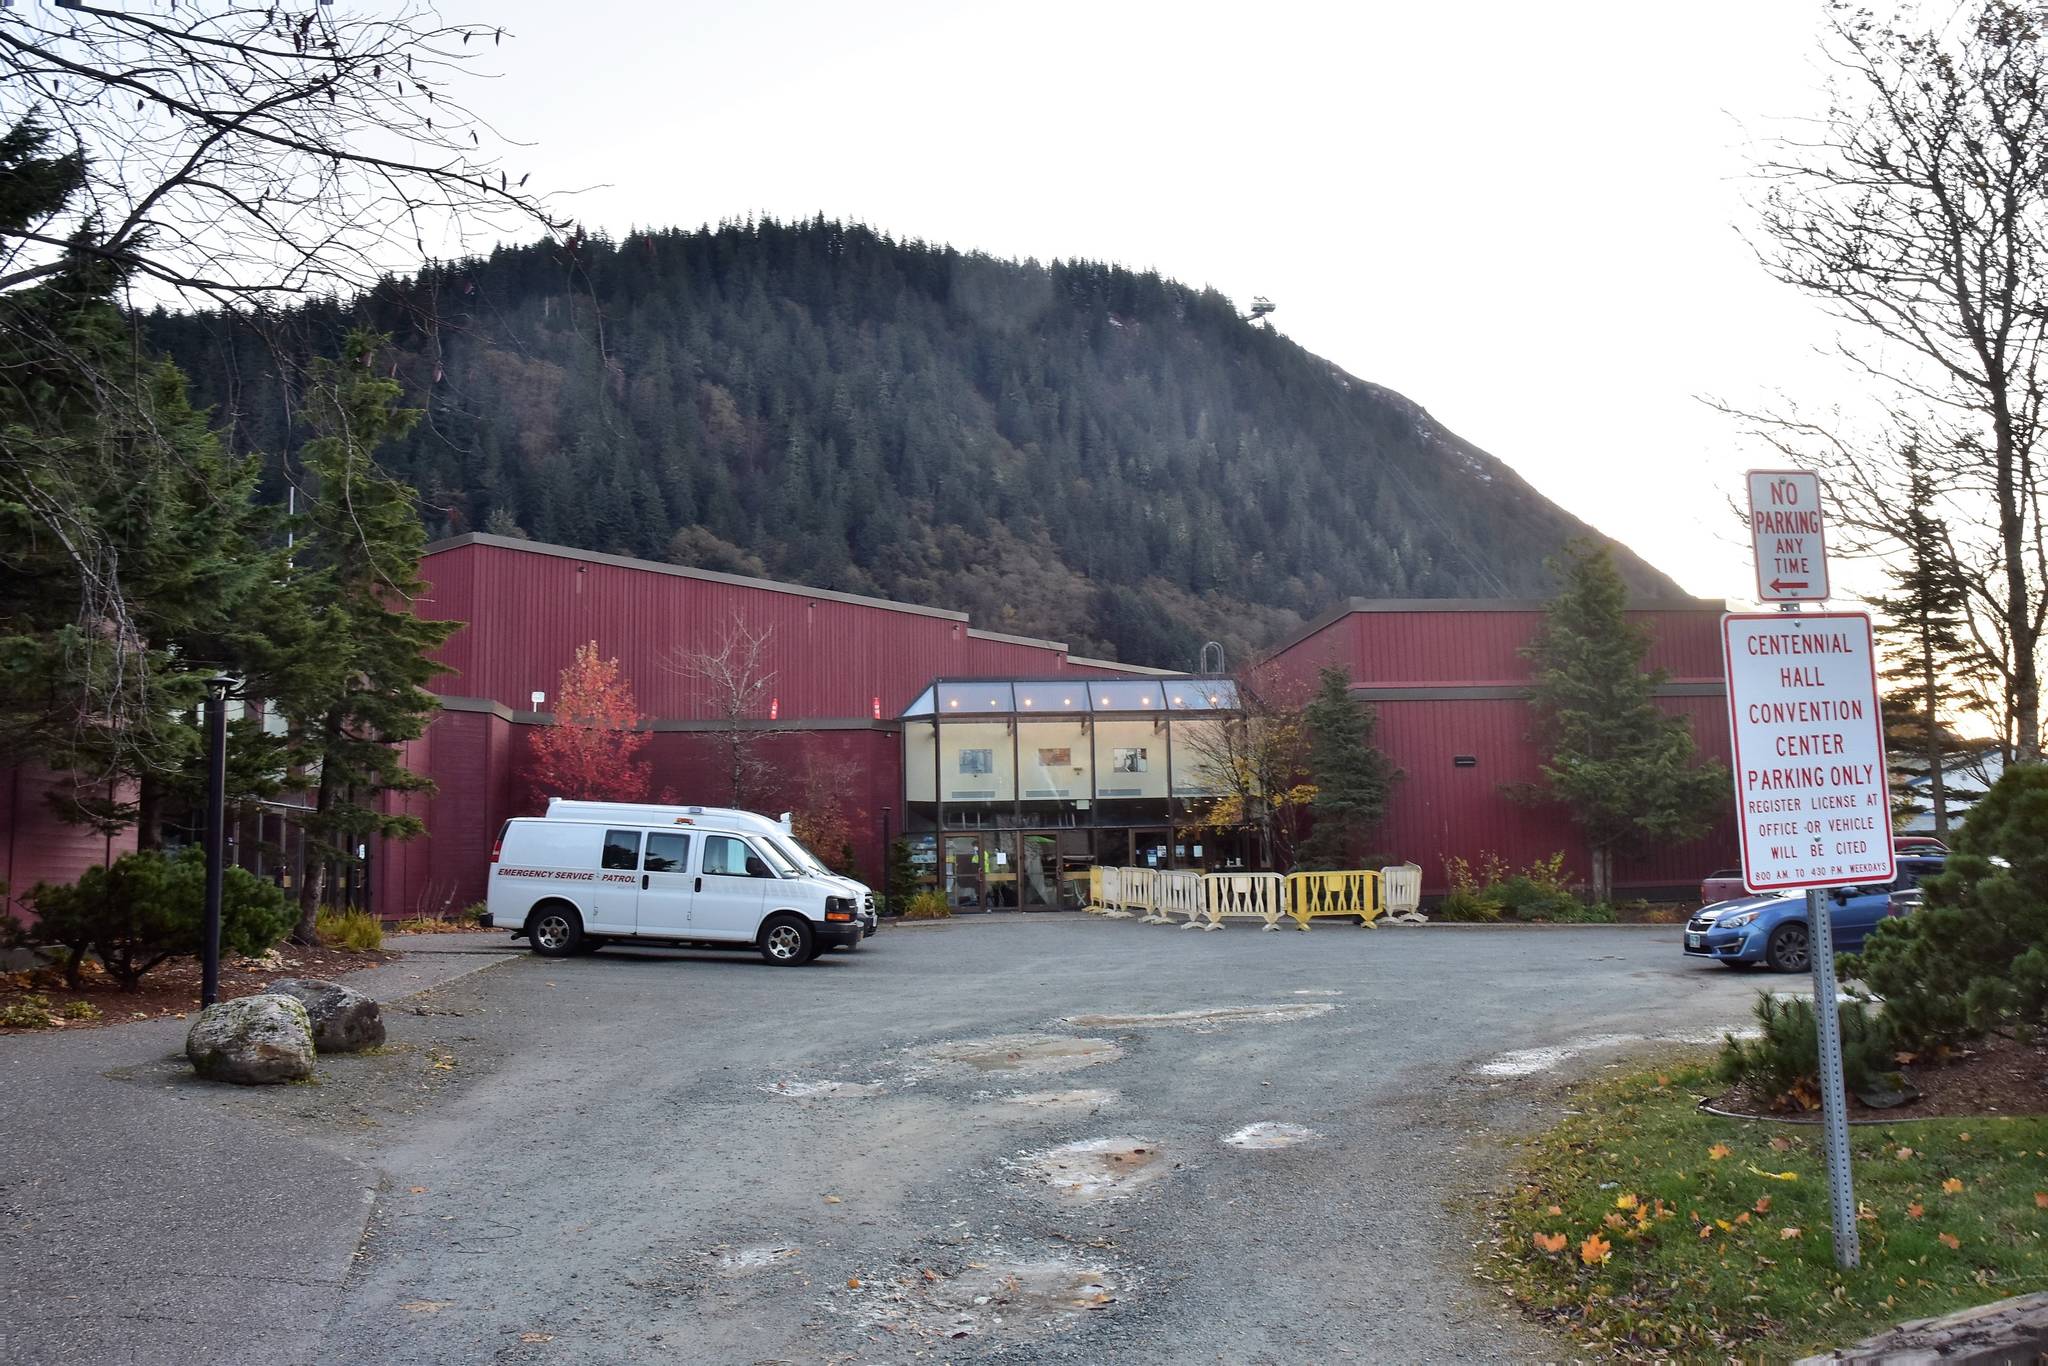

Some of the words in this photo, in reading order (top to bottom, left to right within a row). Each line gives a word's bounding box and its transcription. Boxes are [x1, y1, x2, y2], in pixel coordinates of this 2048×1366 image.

[1771, 482, 1798, 505] NO
[1756, 511, 1819, 534] PARKING
[1776, 538, 1803, 554] ANY
[1774, 558, 1809, 574] TIME
[1748, 633, 1853, 655] CENTENNIAL
[1781, 667, 1824, 687] HALL
[1750, 700, 1863, 724] CONVENTION
[1776, 734, 1844, 756] CENTER
[1748, 767, 1824, 791] PARKING
[1831, 764, 1873, 786] ONLY
[1749, 799, 1800, 813] REGISTER
[1812, 795, 1856, 810] LICENSE
[1867, 793, 1878, 806] AT
[1759, 822, 1798, 837] OFFICE
[1807, 820, 1821, 833] OR
[1828, 817, 1874, 832] VEHICLE
[1771, 846, 1797, 859] WILL
[1811, 843, 1824, 857] BE
[1836, 840, 1867, 855] CITED
[498, 868, 554, 880] EMERGENCY
[555, 871, 594, 880] SERVICE
[601, 874, 636, 883] PATROL
[1795, 868, 1805, 878] TO
[1849, 862, 1887, 873] WEEKDAYS
